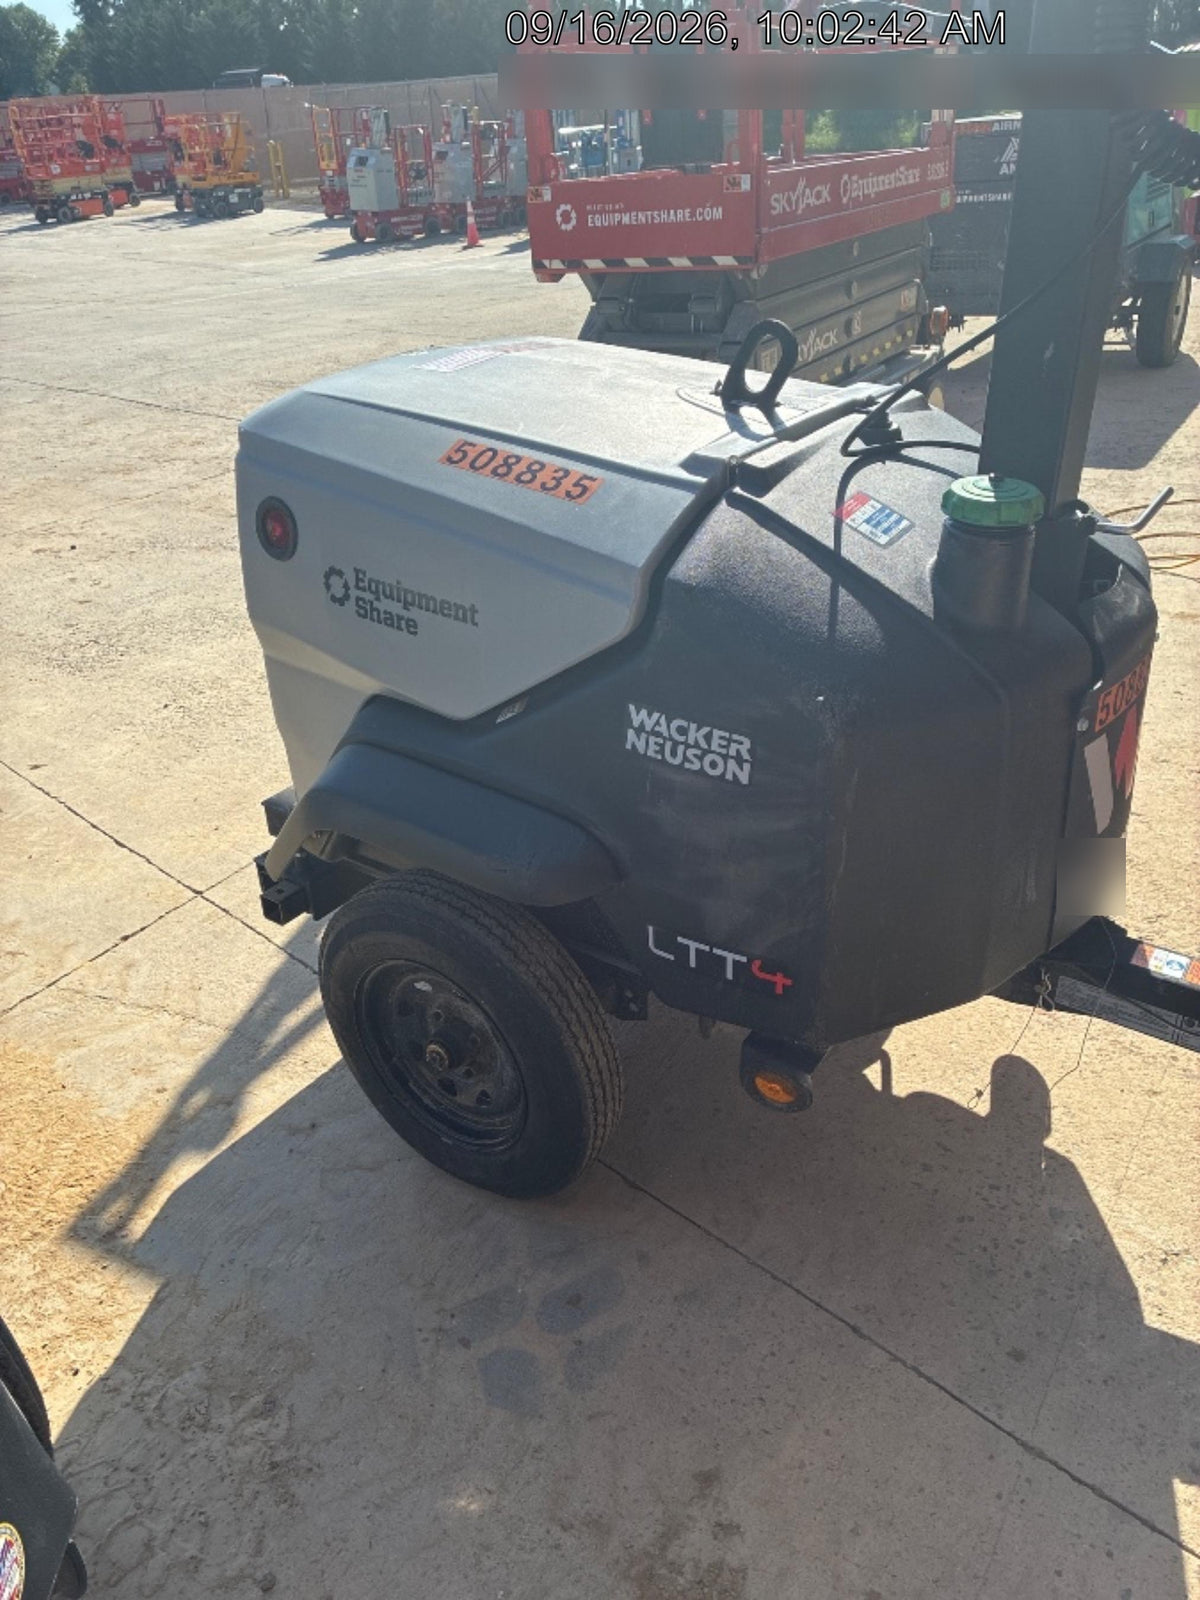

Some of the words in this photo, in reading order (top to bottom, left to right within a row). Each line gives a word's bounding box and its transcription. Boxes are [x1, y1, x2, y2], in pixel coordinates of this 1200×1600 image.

[587, 206, 723, 227] EQUIPMENTSHARE.COM
[770, 177, 831, 215] SKYJACK
[446, 440, 598, 500] 508835
[353, 567, 479, 627] Equipment
[355, 595, 419, 636] Share
[625, 728, 751, 785] NEUSON
[628, 703, 752, 761] WACKER
[648, 925, 792, 995] LTT4
